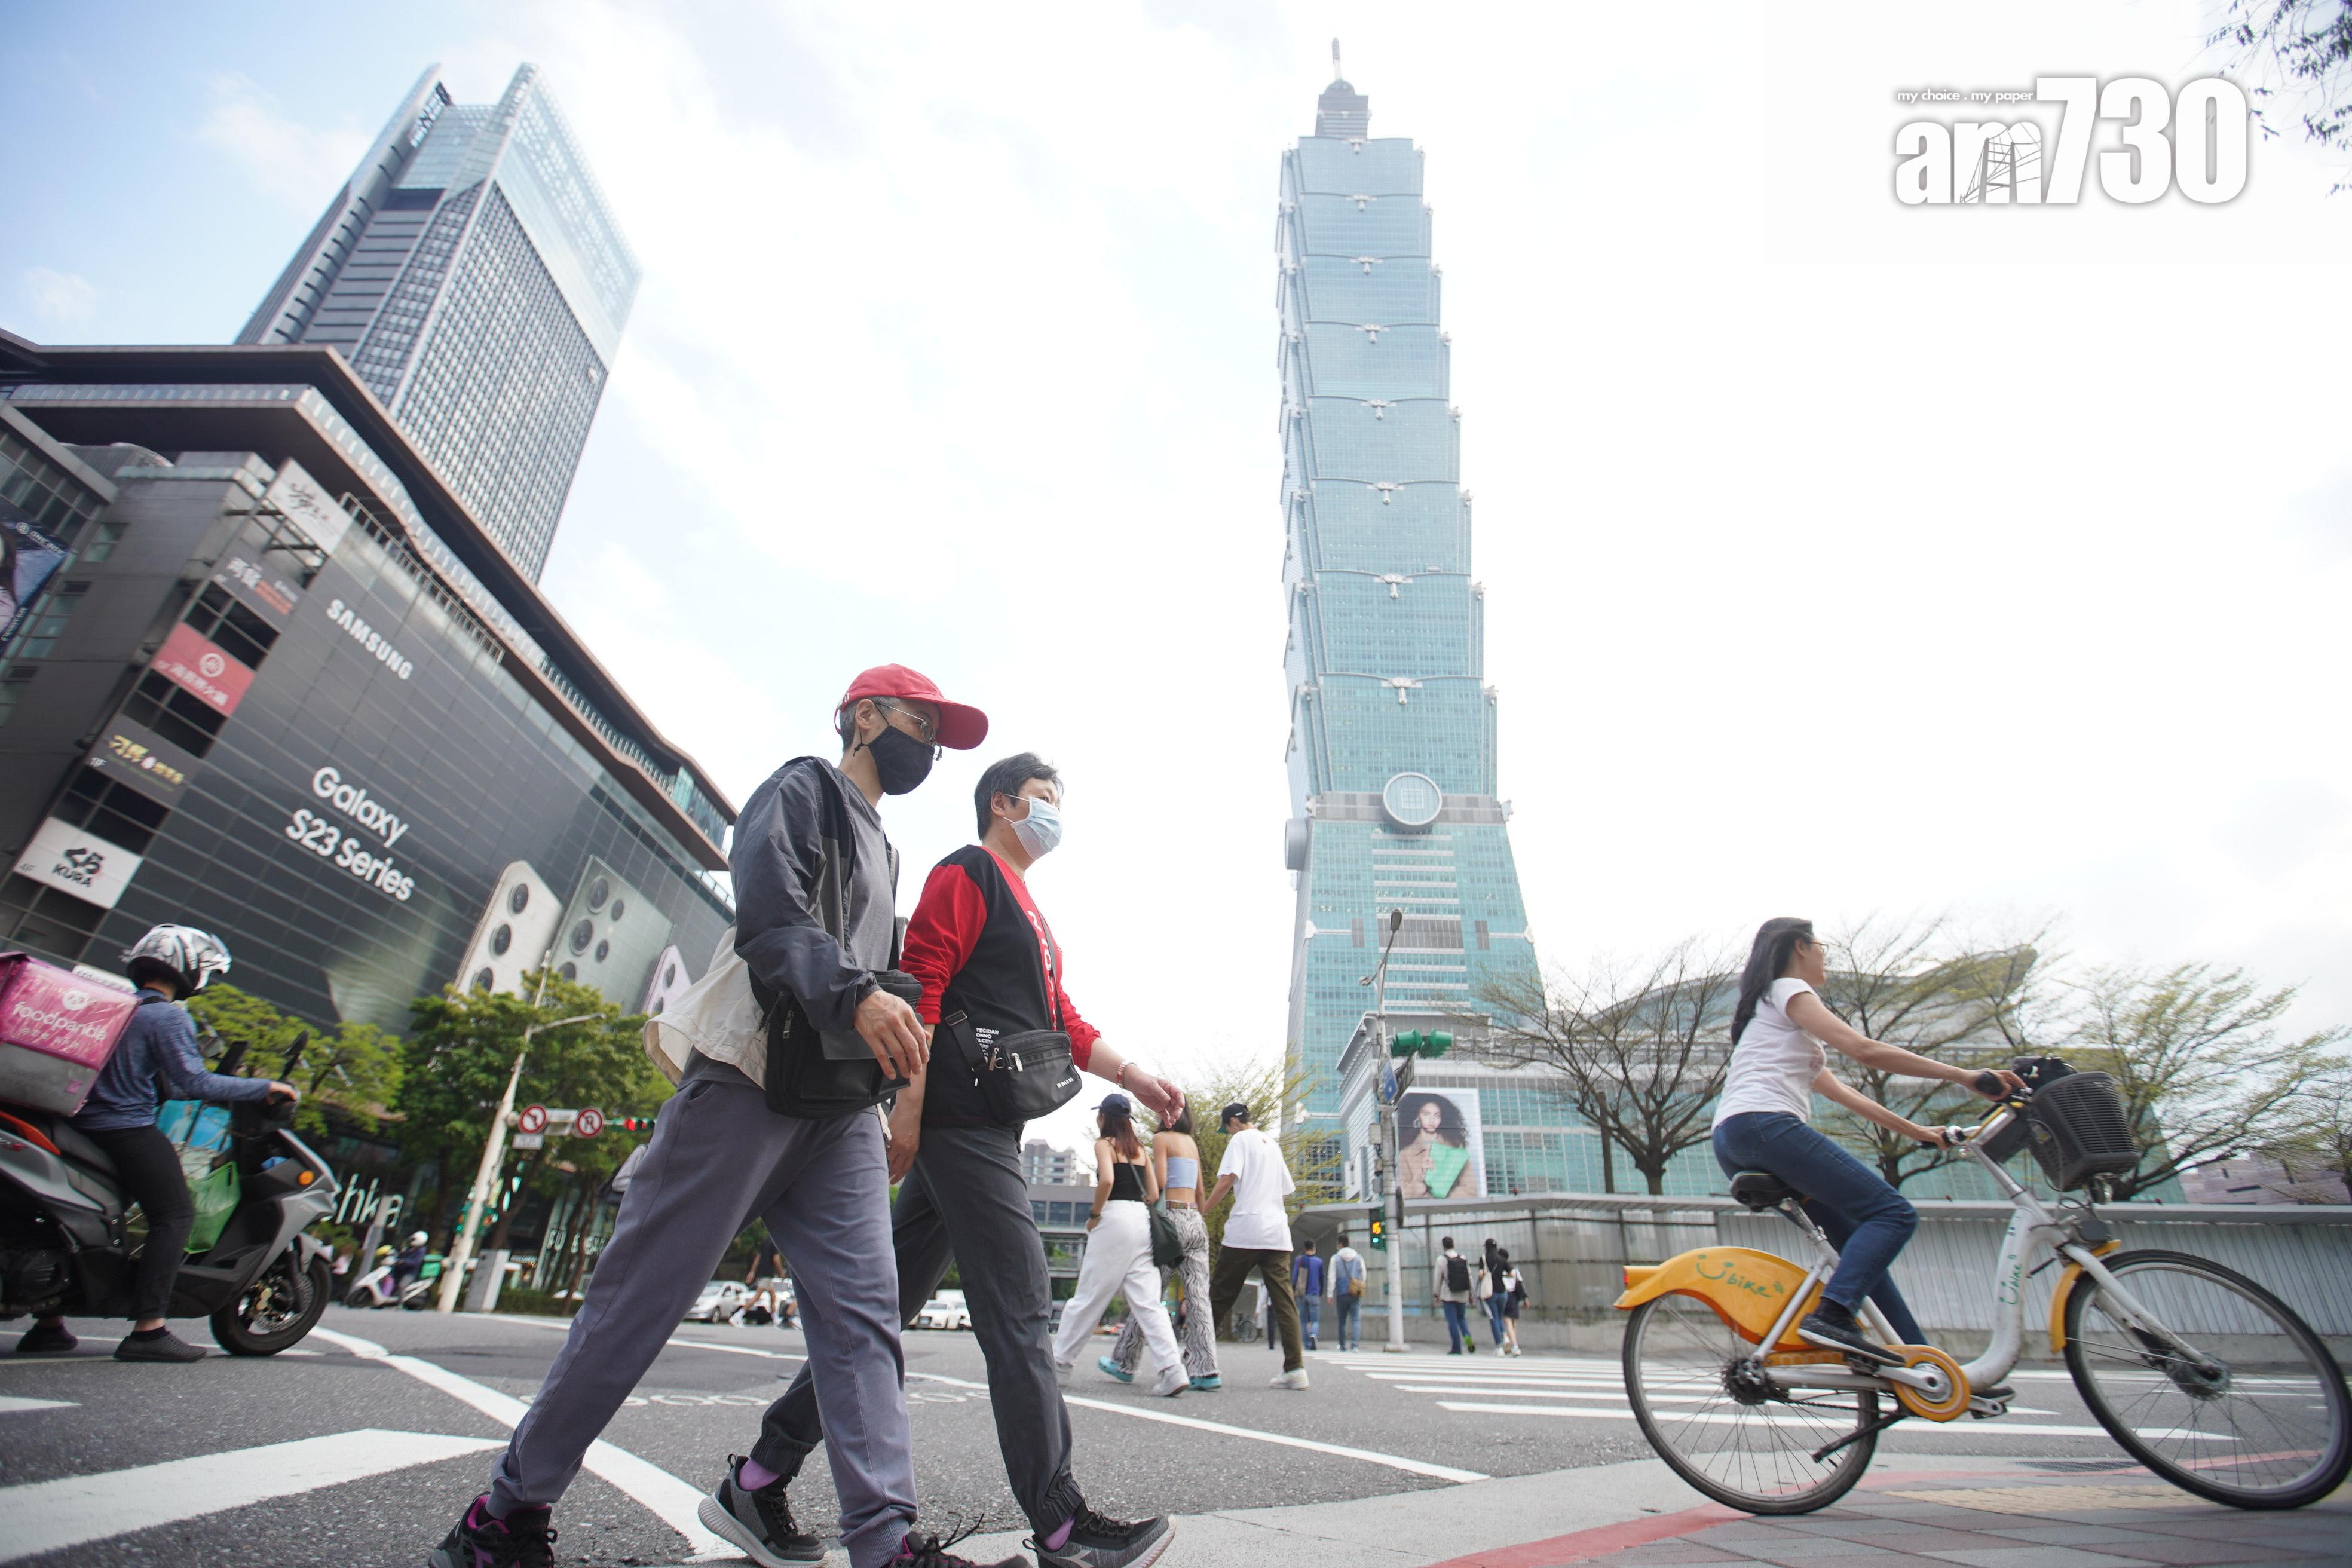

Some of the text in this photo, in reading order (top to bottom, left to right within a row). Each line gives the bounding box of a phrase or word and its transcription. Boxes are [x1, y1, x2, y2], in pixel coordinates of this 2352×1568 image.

[326, 599, 414, 680] SAMSUNG
[313, 766, 410, 849] Galaxy
[51, 863, 93, 888] KURA
[285, 808, 415, 901] S23 Series
[12, 1001, 108, 1041] foodpanda
